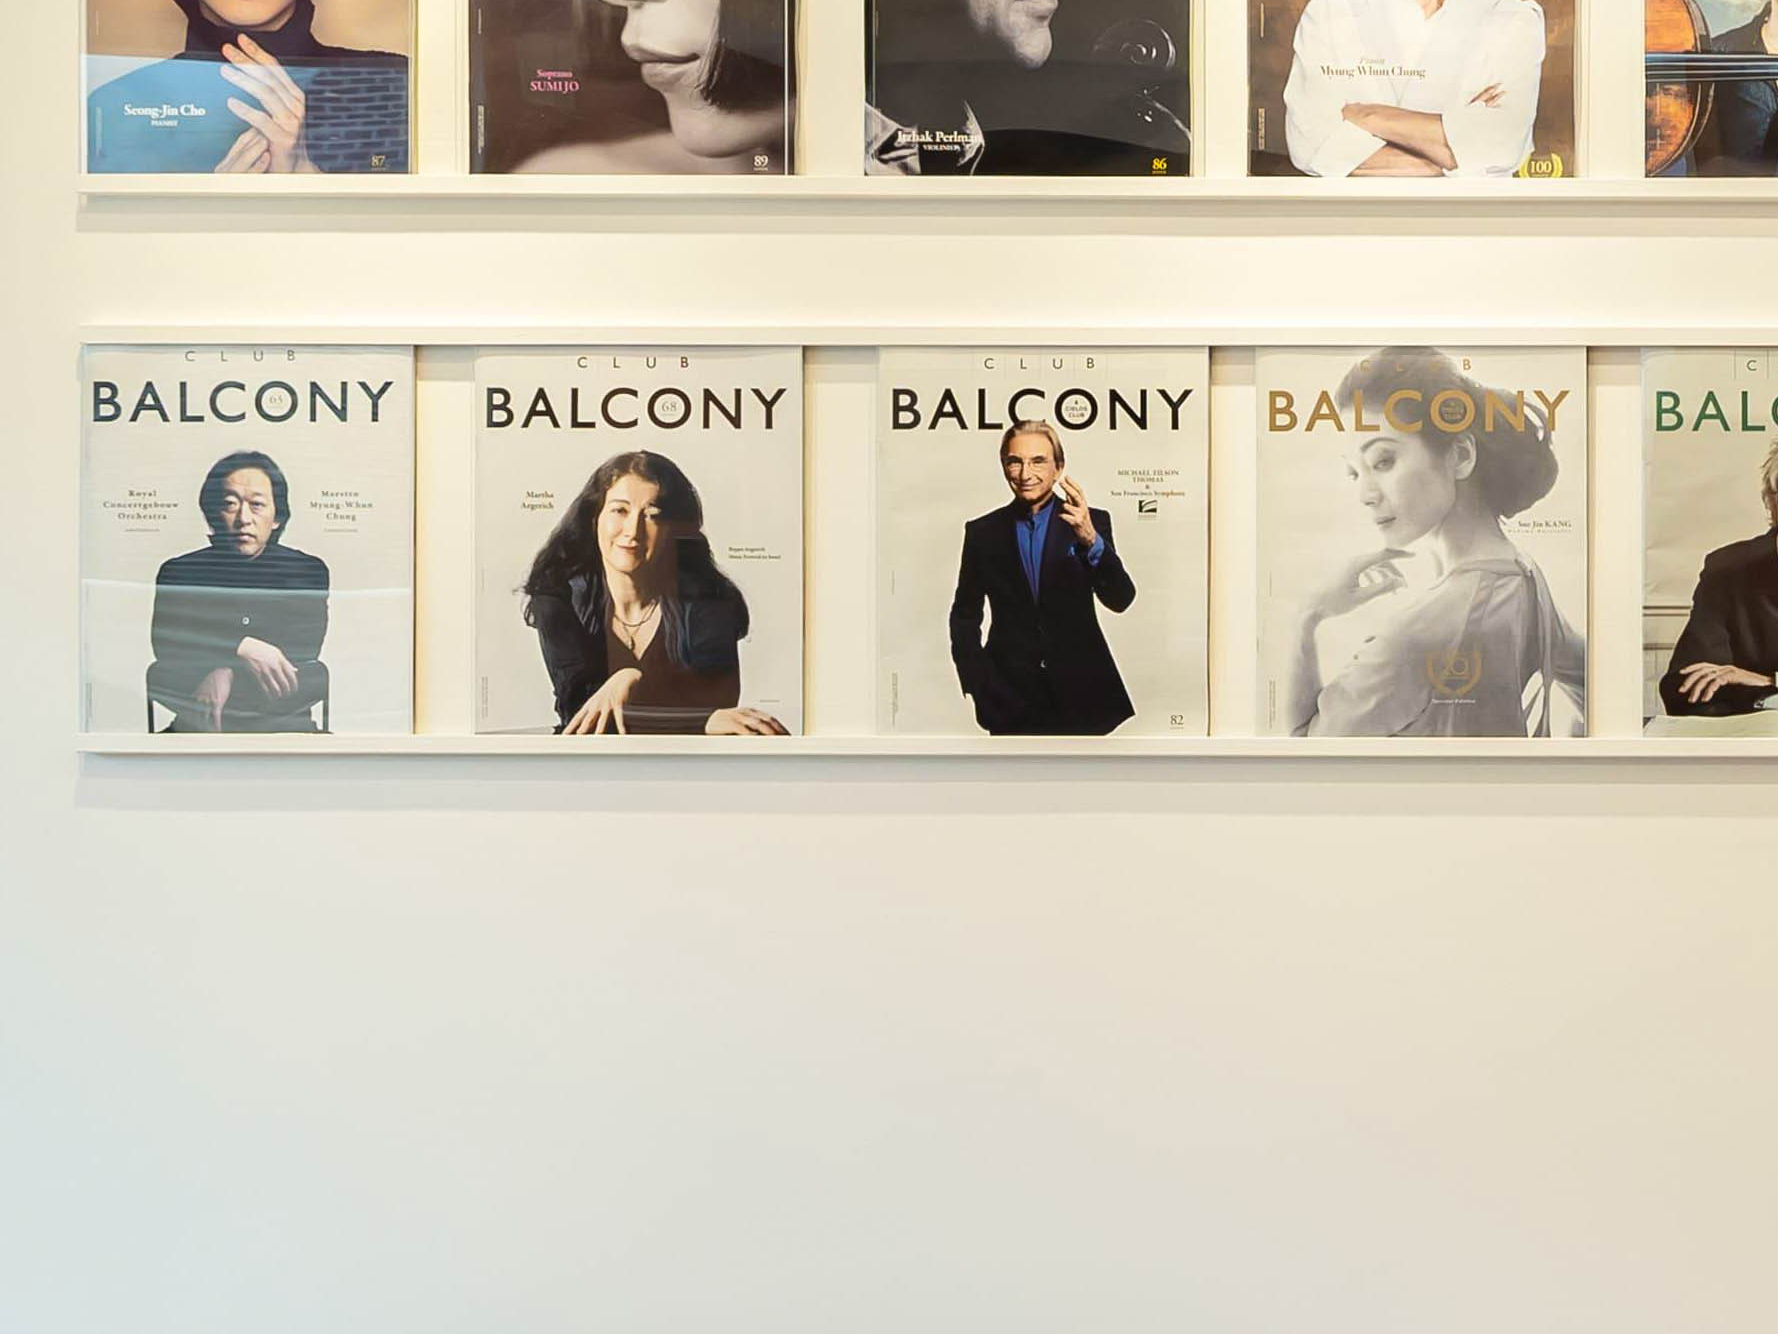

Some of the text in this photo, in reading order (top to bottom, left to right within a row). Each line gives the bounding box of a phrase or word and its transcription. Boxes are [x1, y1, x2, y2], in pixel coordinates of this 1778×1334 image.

[124, 103, 206, 119] Seong-Jin Cho
[371, 155, 386, 167] 87
[753, 154, 768, 167] 89
[1152, 157, 1167, 169] 86
[1530, 160, 1552, 173] 100
[185, 351, 295, 362] CLUB
[577, 356, 689, 369] CLUB
[984, 358, 1095, 370] CLUB
[93, 381, 394, 423] BALCONY
[486, 387, 786, 430] BALCONY
[892, 388, 1194, 430] BALCONY
[1268, 390, 1570, 432] BALCONY
[1169, 714, 1184, 725] 82
